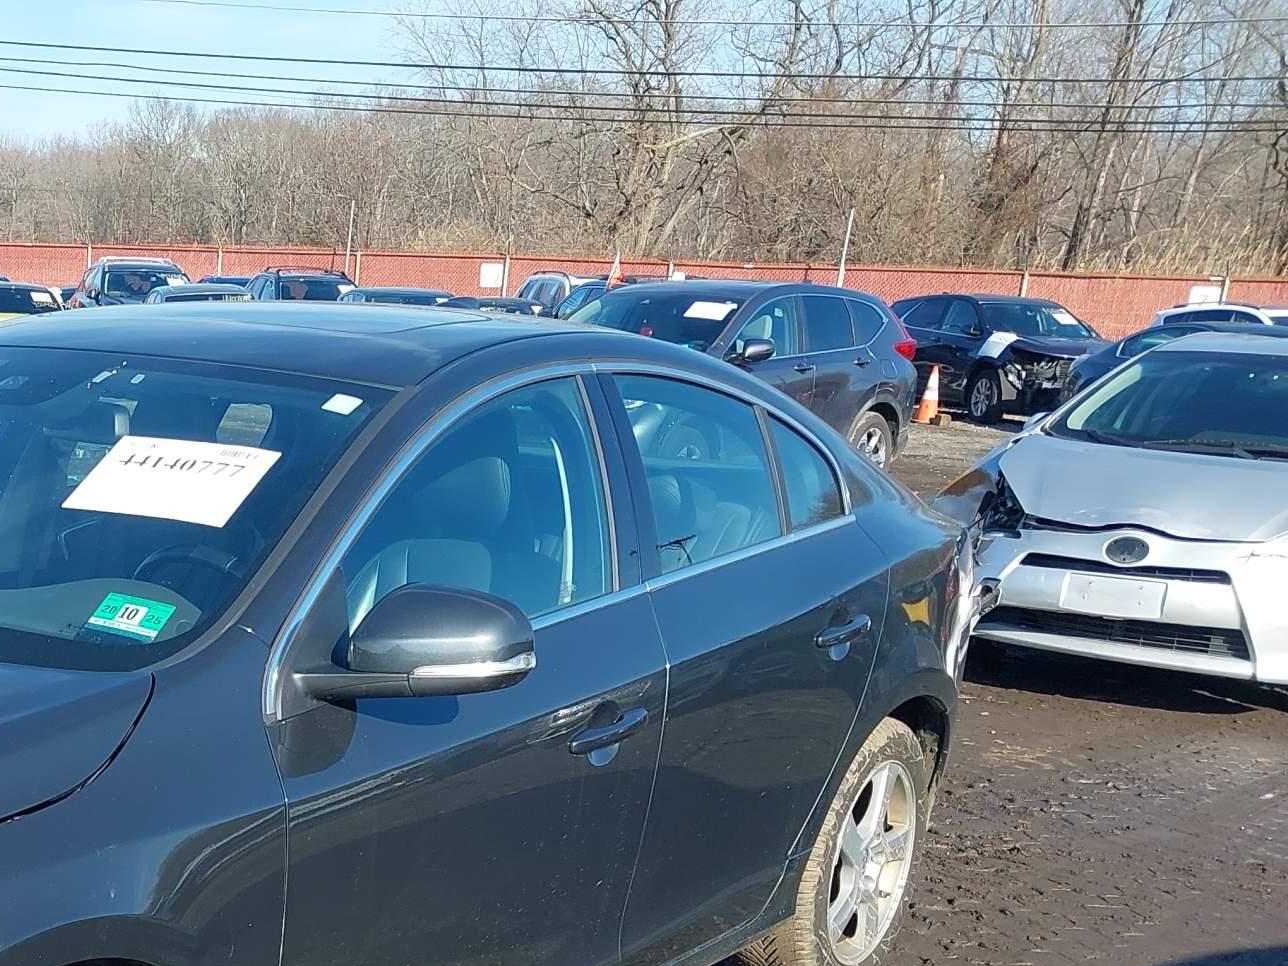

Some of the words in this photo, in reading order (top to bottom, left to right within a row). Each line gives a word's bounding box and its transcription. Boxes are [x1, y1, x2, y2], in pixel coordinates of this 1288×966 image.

[120, 454, 247, 477] 44140777
[101, 604, 118, 615] 20
[118, 606, 139, 621] 10
[144, 614, 162, 625] 25
